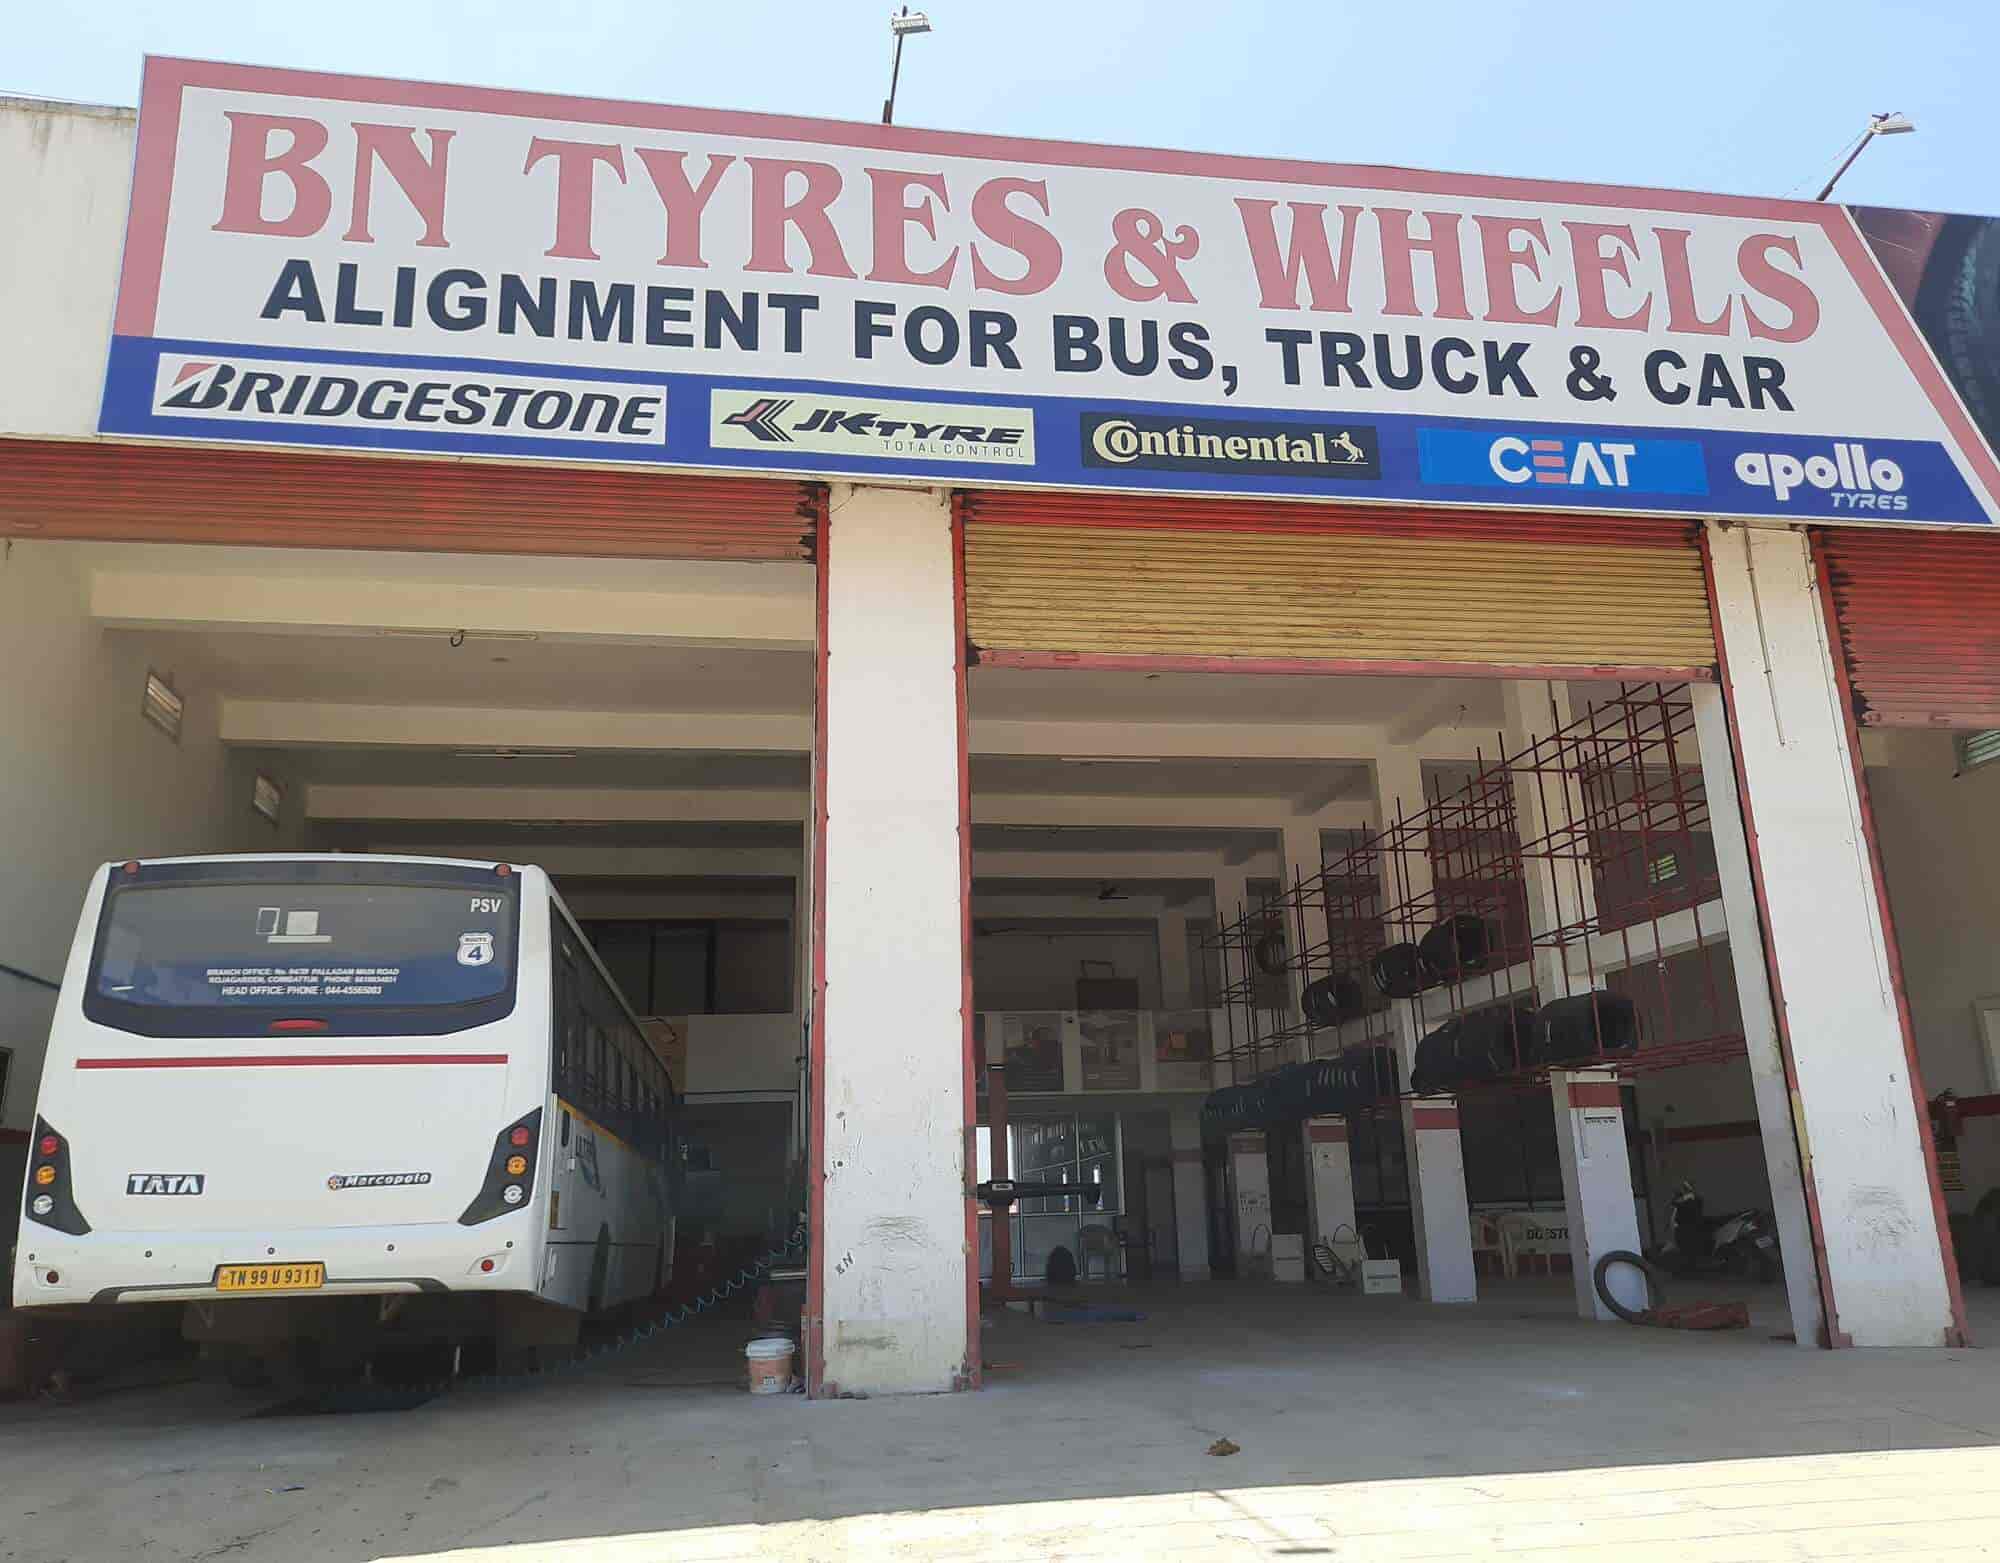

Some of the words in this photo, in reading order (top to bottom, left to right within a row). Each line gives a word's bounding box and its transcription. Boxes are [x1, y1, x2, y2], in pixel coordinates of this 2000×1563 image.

[211, 110, 457, 248] BN
[522, 135, 1063, 297] TYRES
[1103, 207, 1199, 304] &
[1233, 197, 1821, 344] WHEELS
[260, 259, 819, 352] ALIGNMENT
[853, 299, 1023, 371] FOR
[1052, 314, 1238, 397] BUS,
[1265, 327, 1539, 399] TRUCK
[1565, 345, 1618, 402] &
[1643, 349, 1796, 412] CAR
[161, 362, 661, 437] BRIDGESTONE
[883, 439, 938, 454] TOTAL
[943, 443, 1025, 459] CONTROL
[1092, 419, 1330, 464] Continental
[1488, 436, 1636, 487] CEAT
[1734, 443, 1904, 501] apollo
[1830, 491, 1909, 511] TYRES
[470, 898, 501, 912] PSV
[468, 945, 482, 960] 4
[221, 986, 248, 995] HEAD
[130, 1174, 201, 1194] TATA
[344, 1172, 429, 1187] Marcopolo
[228, 1269, 247, 1286] TN
[250, 1268, 269, 1285] 99
[272, 1267, 281, 1284] U
[285, 1266, 321, 1284] 9311
